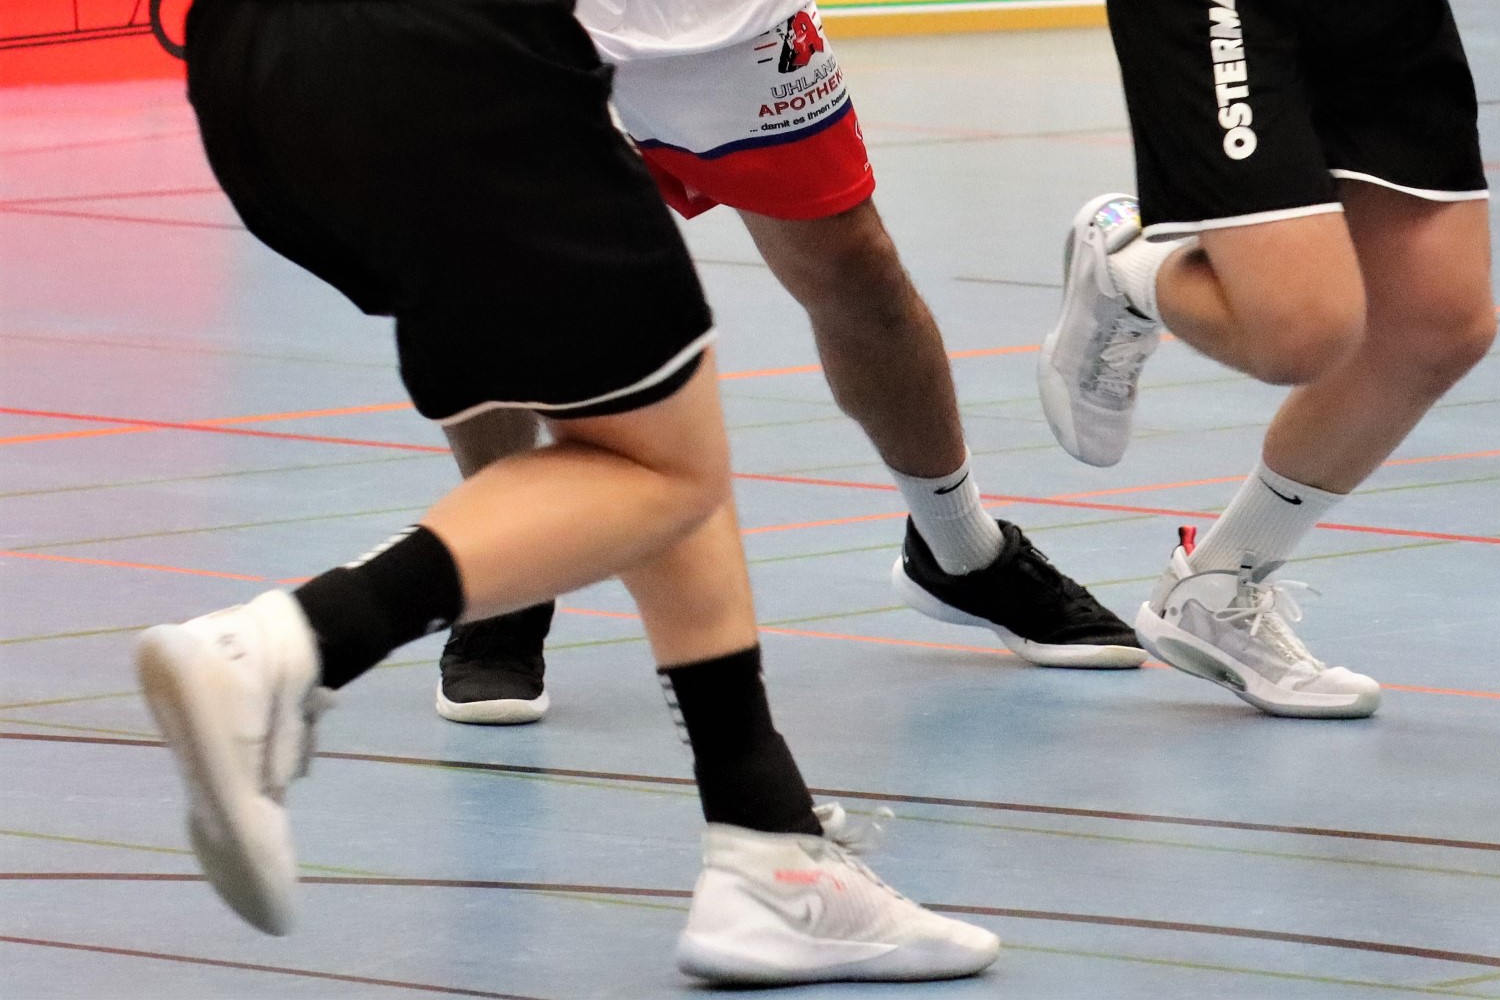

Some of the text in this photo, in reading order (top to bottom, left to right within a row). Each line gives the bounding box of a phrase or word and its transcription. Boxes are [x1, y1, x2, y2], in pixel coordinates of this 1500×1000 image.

[758, 67, 844, 118] APOTHEK
[761, 119, 790, 132] damit
[793, 116, 806, 126] es
